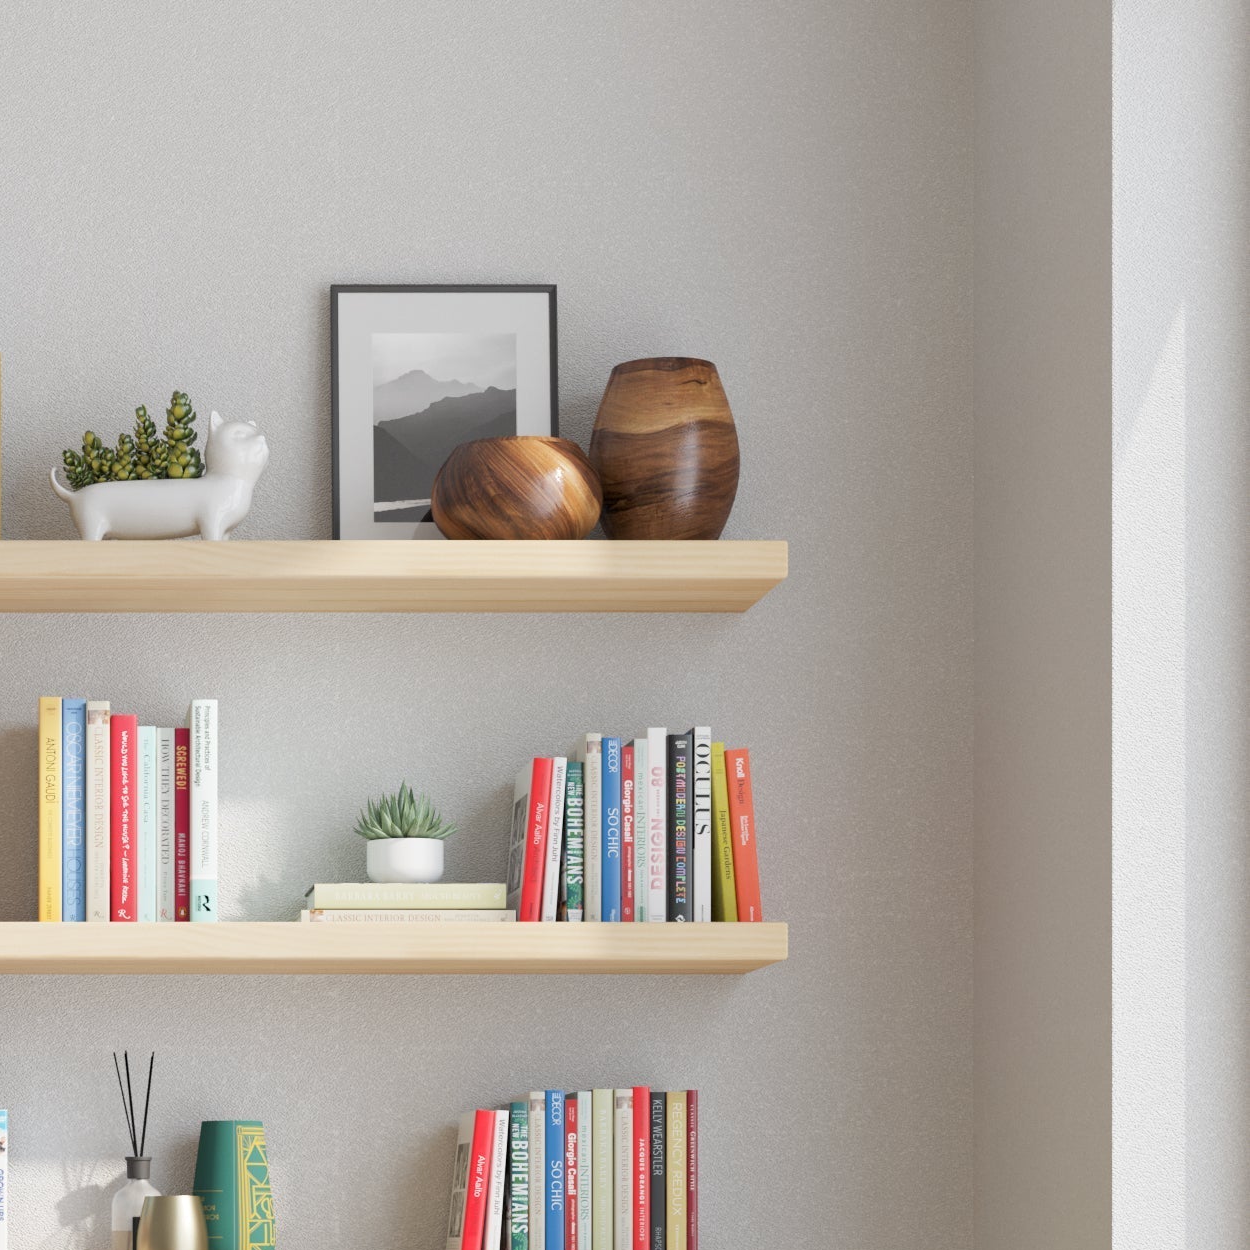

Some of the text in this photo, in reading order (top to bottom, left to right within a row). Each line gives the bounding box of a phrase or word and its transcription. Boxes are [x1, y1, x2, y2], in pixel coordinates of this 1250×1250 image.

[94, 727, 104, 764] CLASSIC
[161, 739, 170, 763] HOW
[176, 745, 187, 790] SCREWED!
[65, 722, 82, 846] OSCAR NIEMEYER
[94, 767, 104, 811] INTERIOR
[161, 768, 170, 795] THEY
[555, 766, 564, 815] Watercolors
[567, 782, 575, 796] NEW
[622, 780, 633, 813] Giorgio
[651, 766, 663, 787] 80
[695, 743, 710, 835] OCULUS
[736, 758, 745, 804] Knoll Design
[94, 814, 104, 848] DESIGN
[161, 800, 170, 864] DECORATED
[533, 802, 544, 845] Alvar Aalto
[553, 817, 560, 827] by
[567, 798, 583, 884] BOHEMIANS
[608, 808, 618, 858] SO CHIC
[624, 815, 633, 842] Casali
[676, 756, 686, 903] POSTMODERN DESIGN COMPLETE
[651, 818, 663, 890] DESIGN
[719, 810, 732, 880] Japanese Gardens
[512, 1123, 520, 1138] NEW
[566, 1133, 576, 1166] Giorgio
[653, 1099, 662, 1175] KELLY WEARSTLER
[474, 1155, 486, 1197] Alvar Aalto
[672, 1102, 682, 1216] REGENCY REDUX
[512, 1141, 528, 1233] BOHEMIANS
[551, 1160, 562, 1211] SO CHIC
[568, 1168, 576, 1195] Casali
